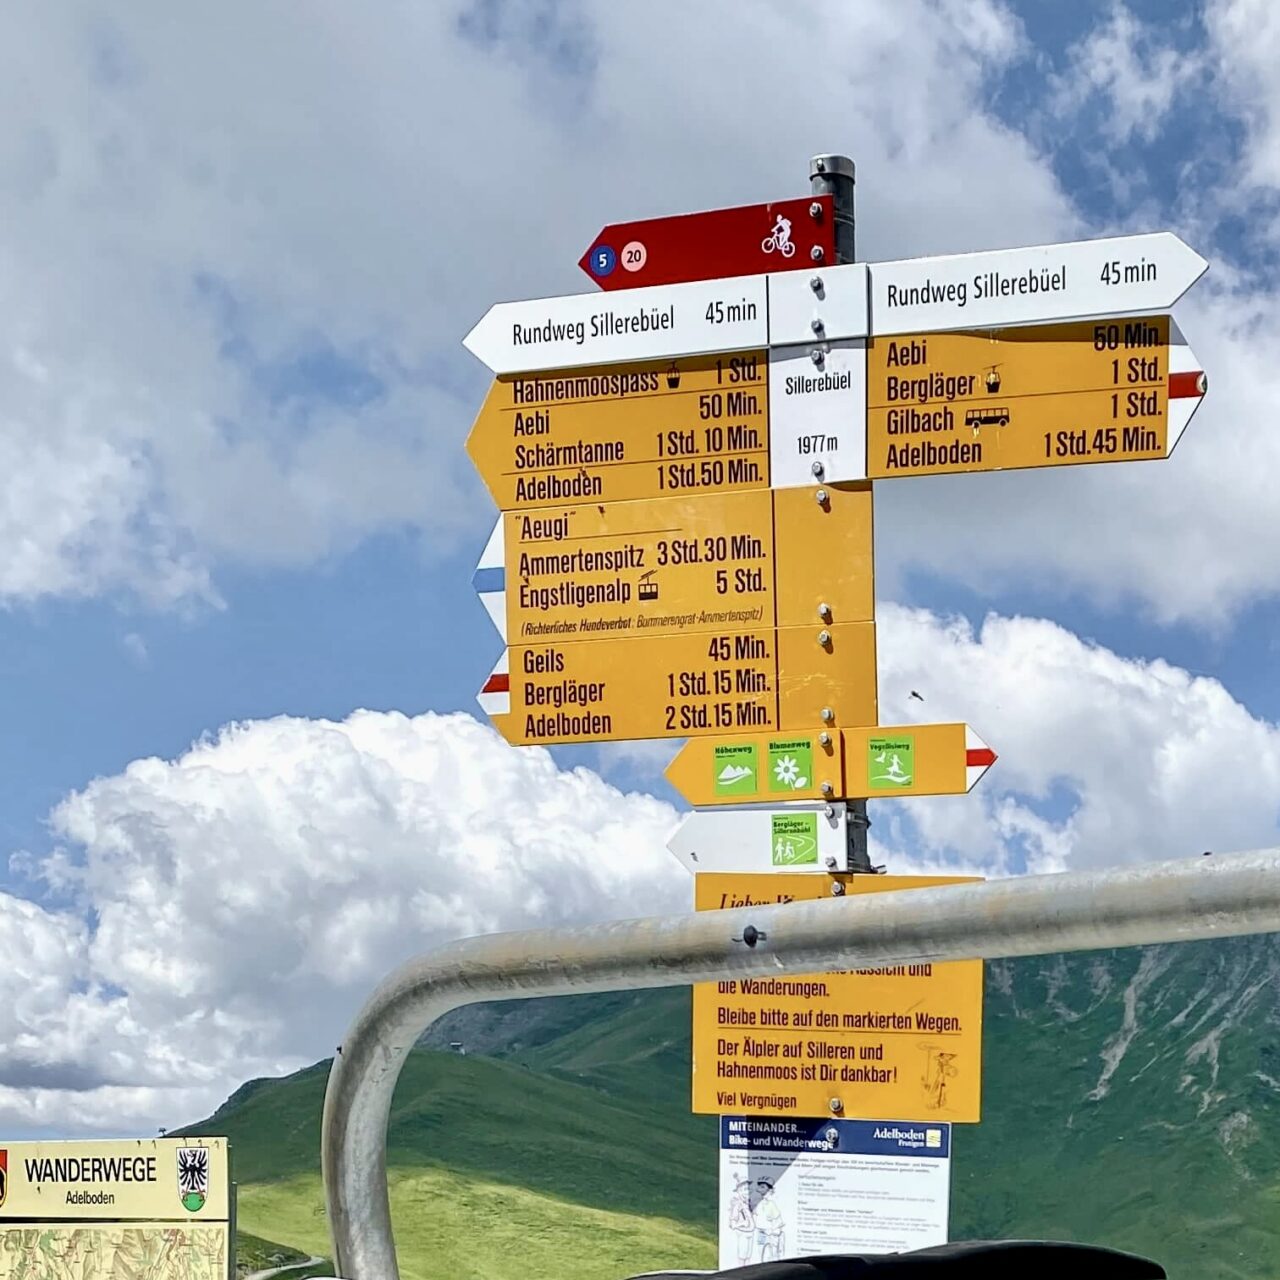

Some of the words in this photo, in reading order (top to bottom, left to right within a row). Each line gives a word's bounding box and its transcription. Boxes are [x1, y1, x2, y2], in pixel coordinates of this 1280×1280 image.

[599, 254, 607, 268] 5
[626, 249, 642, 264] 20
[887, 279, 967, 307] Rundweg
[973, 265, 1066, 298] Sillerebüel
[513, 318, 585, 345] Rundweg
[590, 305, 675, 337] Sillerebüel
[887, 339, 927, 367] Aebi
[1093, 325, 1119, 351] 50
[1124, 322, 1164, 348] Min.
[513, 371, 659, 404] Hahnenmoospass
[716, 361, 722, 384] 1
[729, 357, 762, 383] Std.
[785, 371, 851, 395] Sillerebüel
[887, 372, 976, 403] Bergläger
[1112, 359, 1118, 384] 1
[1127, 356, 1163, 383] Std.
[514, 410, 550, 437] Aebi
[700, 394, 722, 420] 50
[727, 391, 762, 418] Min.
[887, 406, 954, 435] Gilbach
[1111, 393, 1118, 418] 1
[1126, 391, 1162, 417] Std.
[515, 440, 624, 469] Schärmtanne
[705, 427, 723, 453] 10
[728, 425, 763, 451] Min.
[886, 440, 982, 469] Adelboden
[1122, 425, 1161, 452] Min.
[516, 471, 602, 502] Adelboden
[728, 458, 764, 484] Min.
[519, 545, 645, 577] Ammertenspitz
[731, 535, 767, 561] Min.
[520, 578, 631, 611] Engstligenalp
[716, 570, 728, 594] 5
[734, 567, 767, 593] Std.
[523, 649, 564, 674] Geils
[708, 637, 731, 661] 45
[735, 635, 770, 660] Min.
[524, 680, 605, 708] Bergläger
[736, 668, 771, 693] Min.
[525, 711, 612, 738] Adelboden
[665, 705, 676, 730] 2
[737, 701, 771, 726] Min.
[740, 978, 830, 999] Wanderungen.
[718, 1007, 756, 1025] Bleibe
[761, 1009, 789, 1026] bitte
[793, 1010, 813, 1027] auf
[816, 1010, 838, 1028] den
[843, 1012, 912, 1030] markierten
[916, 1012, 962, 1033] Wegen.
[717, 1039, 739, 1056] Der
[743, 1036, 780, 1059] Älpler
[782, 1040, 803, 1057] auf
[807, 1041, 855, 1059] Silleren
[860, 1044, 883, 1060] und
[717, 1062, 797, 1081] Hahnenmoos
[801, 1064, 816, 1081] ist
[820, 1064, 838, 1082] Dir
[717, 1091, 736, 1106] Viel
[740, 1092, 797, 1110] Vergnügen
[753, 1135, 771, 1146] und
[773, 1137, 834, 1150] Wanderwege
[873, 1128, 925, 1141] Adelboden
[898, 1139, 925, 1147] Frutigen
[25, 1157, 156, 1183] WANDERWEGE
[65, 1191, 114, 1204] Adelboden
